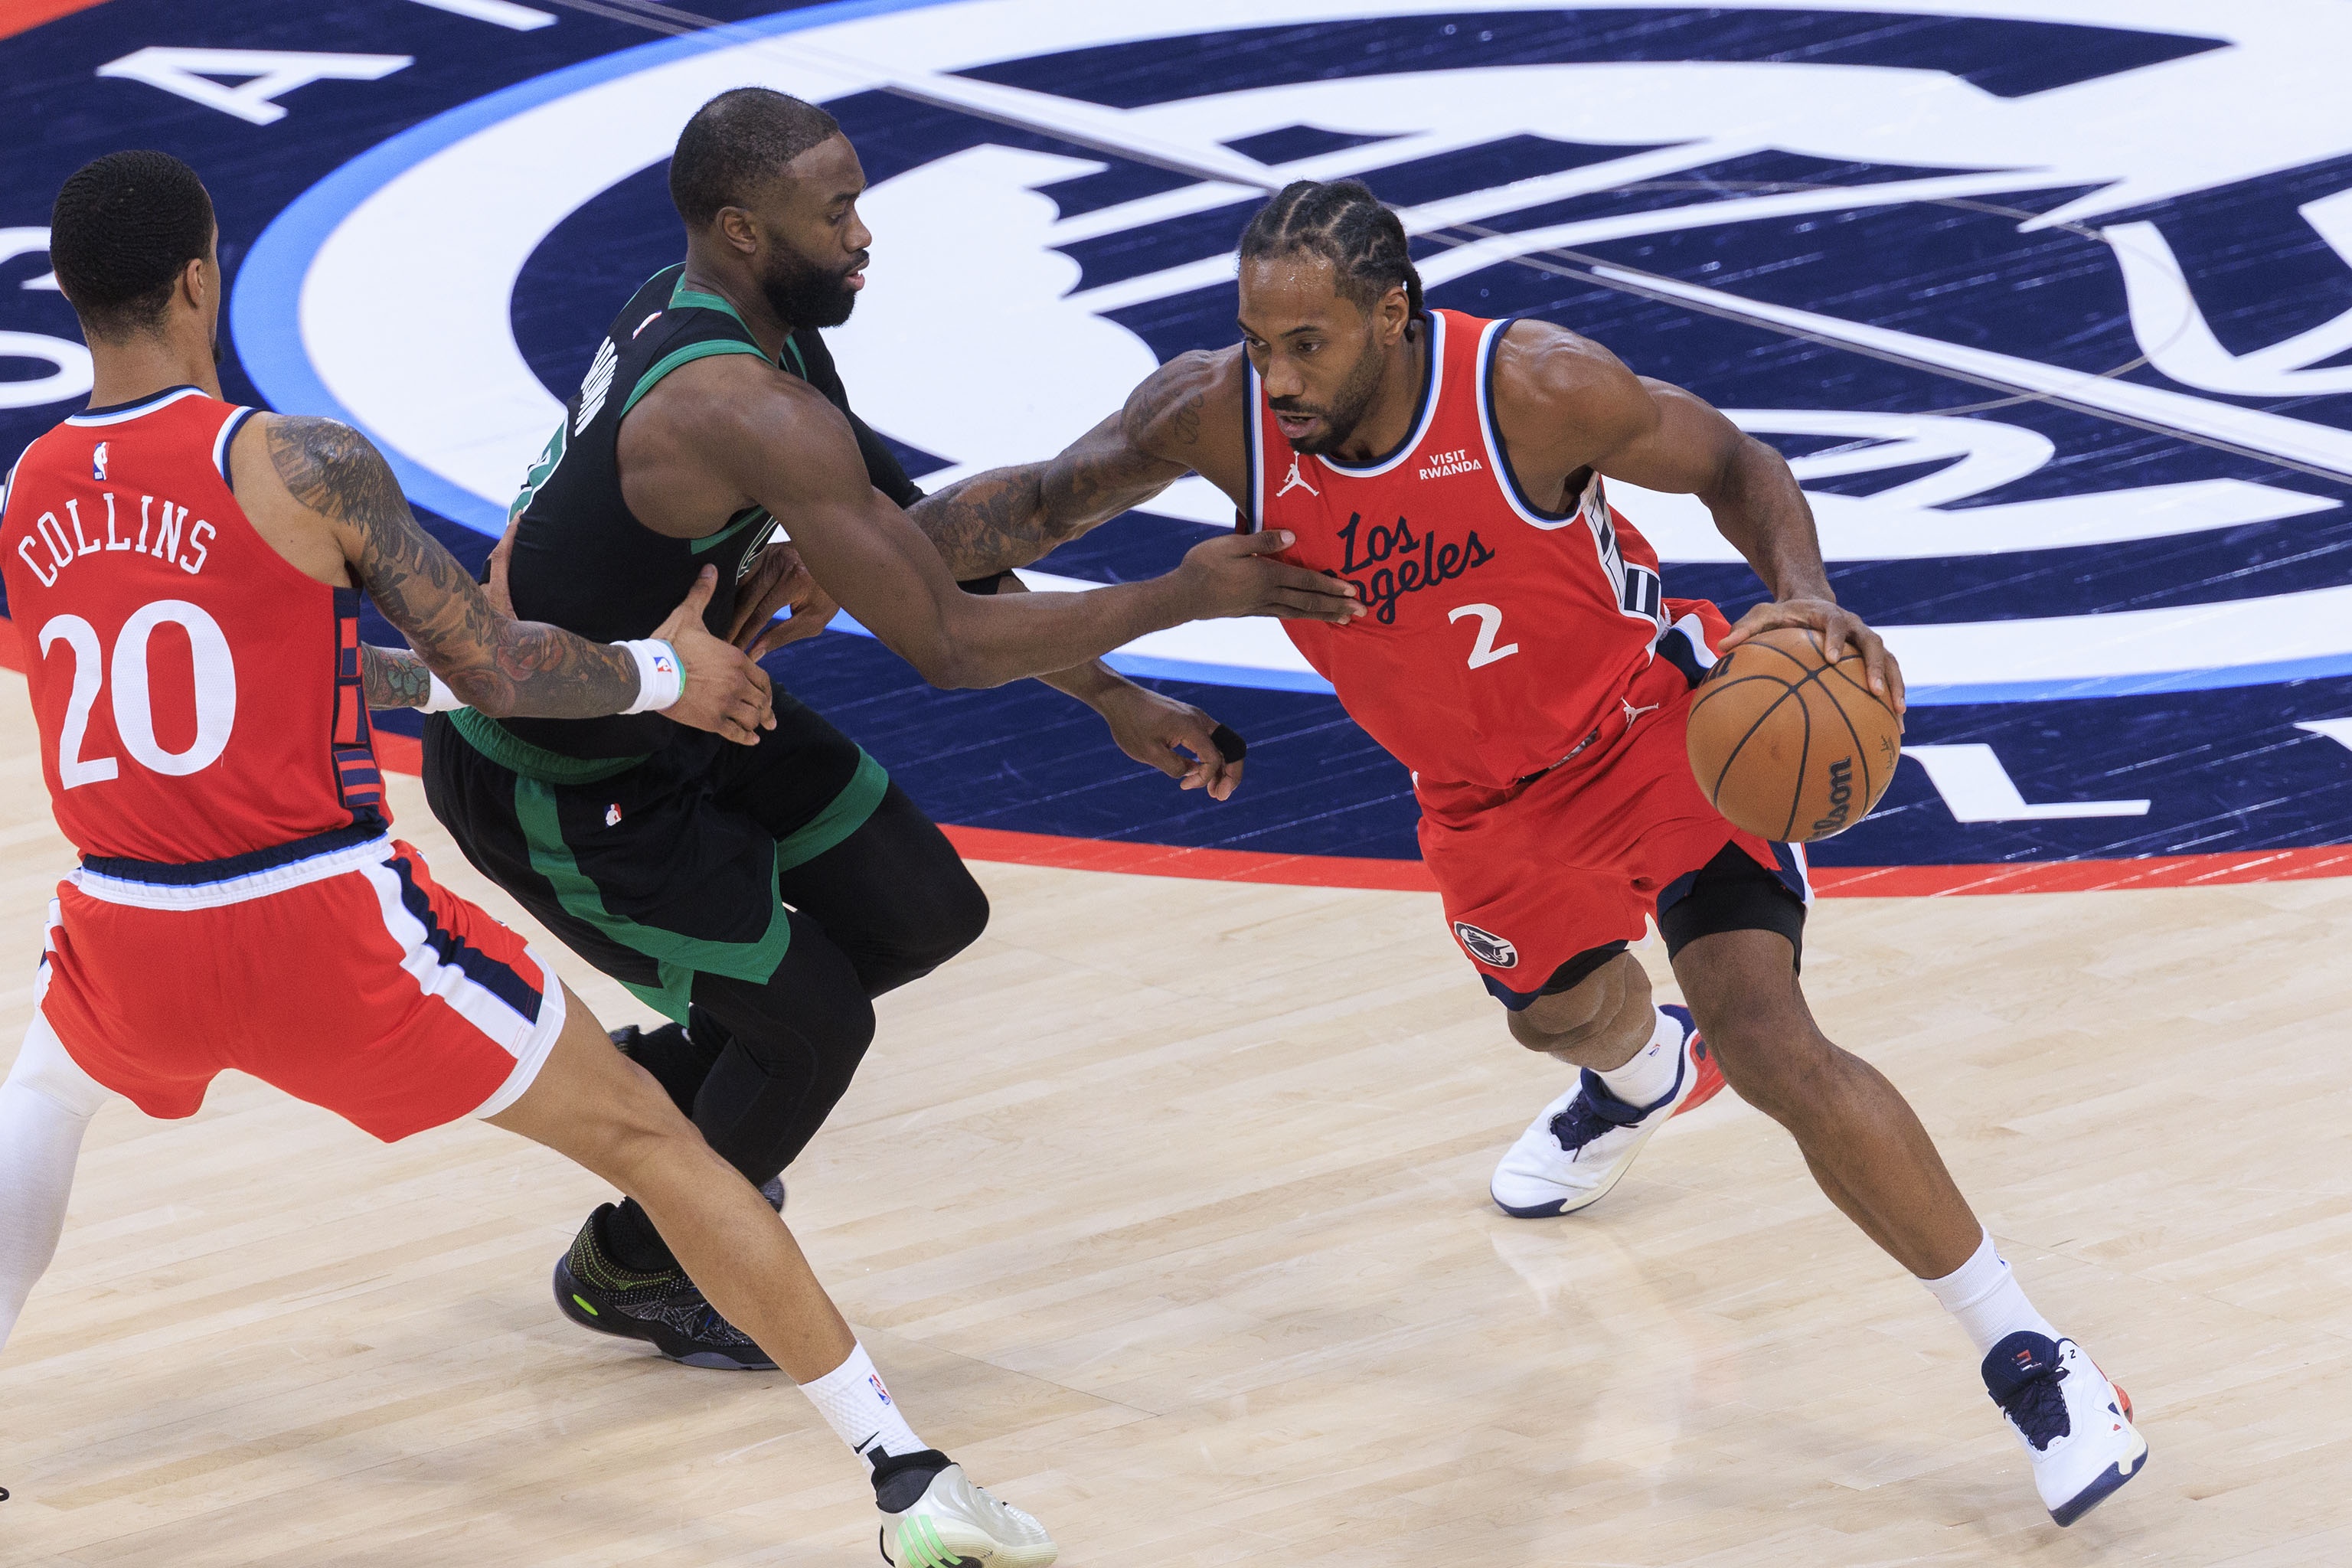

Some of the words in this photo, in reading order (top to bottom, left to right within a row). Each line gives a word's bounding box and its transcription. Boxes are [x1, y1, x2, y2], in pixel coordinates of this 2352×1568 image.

[1419, 459, 1482, 480] RWANDA
[1429, 449, 1465, 466] VISIT
[18, 492, 217, 587] COLLINS
[1336, 511, 1420, 575] Los
[1321, 530, 1495, 625] ngeles
[1448, 603, 1519, 670] 2
[38, 599, 237, 790] 20
